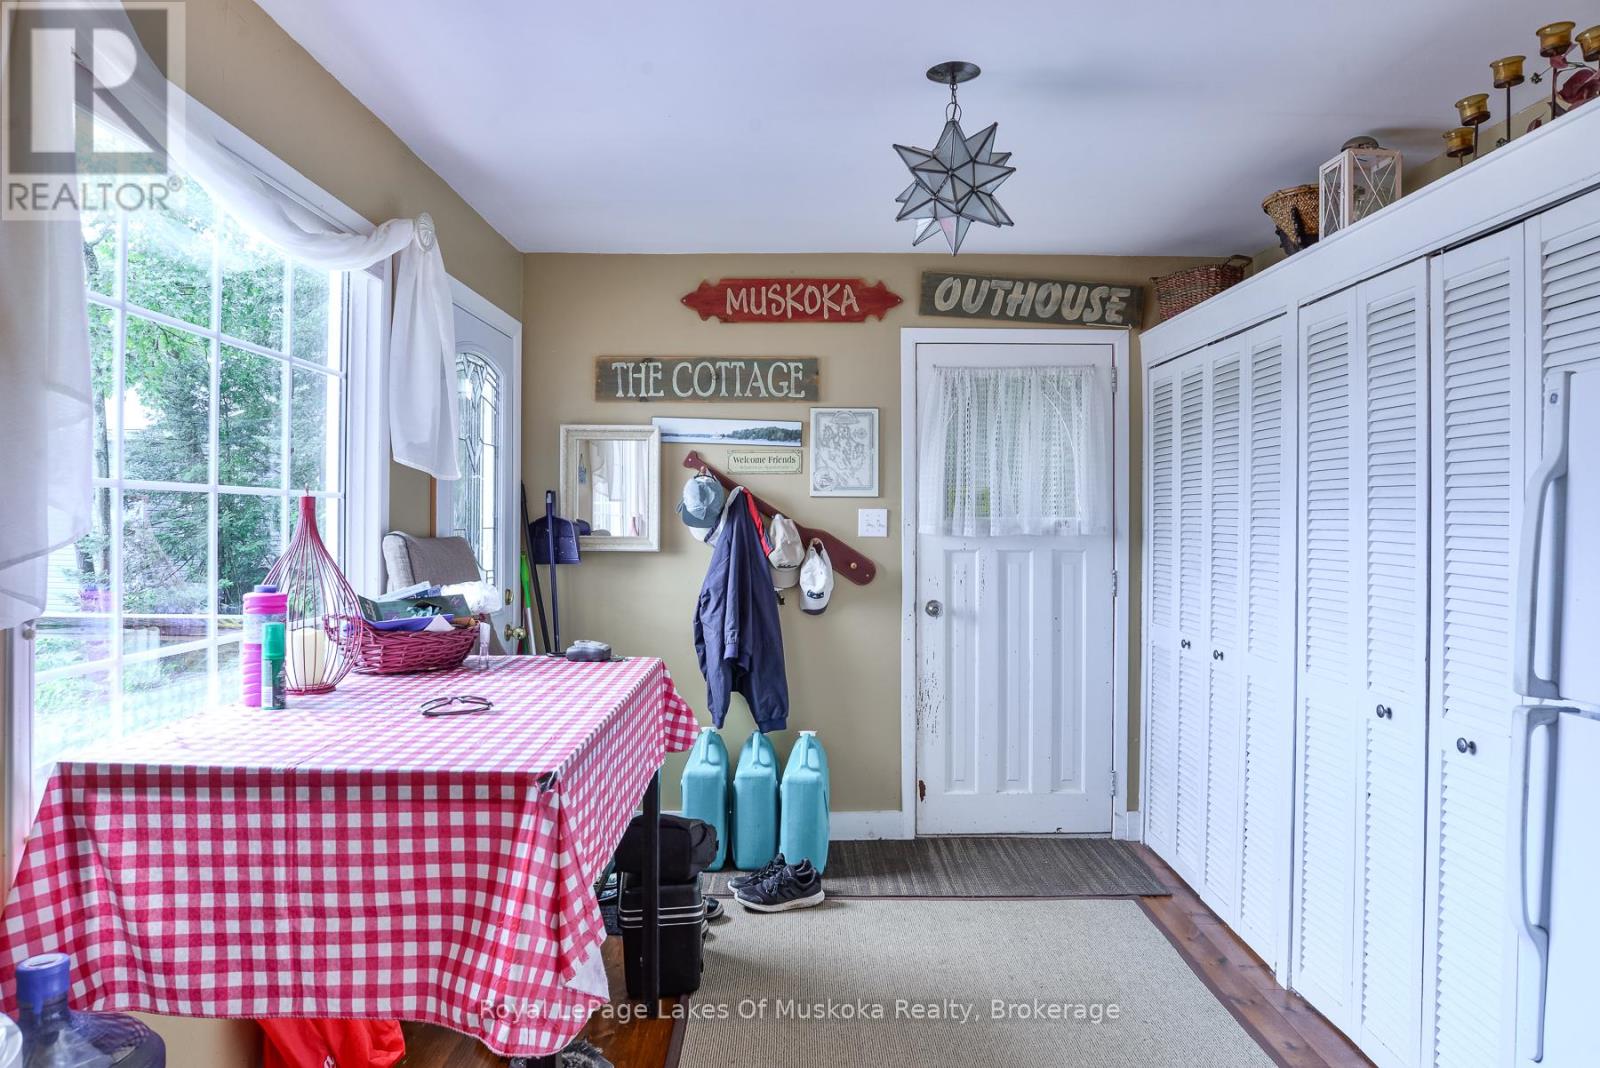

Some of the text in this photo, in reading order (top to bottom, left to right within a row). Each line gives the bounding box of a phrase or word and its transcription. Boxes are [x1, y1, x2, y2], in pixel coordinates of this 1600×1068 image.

[725, 283, 860, 319] MUSKOKA
[934, 276, 1131, 323] OUTHOUSE
[611, 361, 806, 398] THE COTTAGE
[733, 455, 796, 464] Welcome Friends
